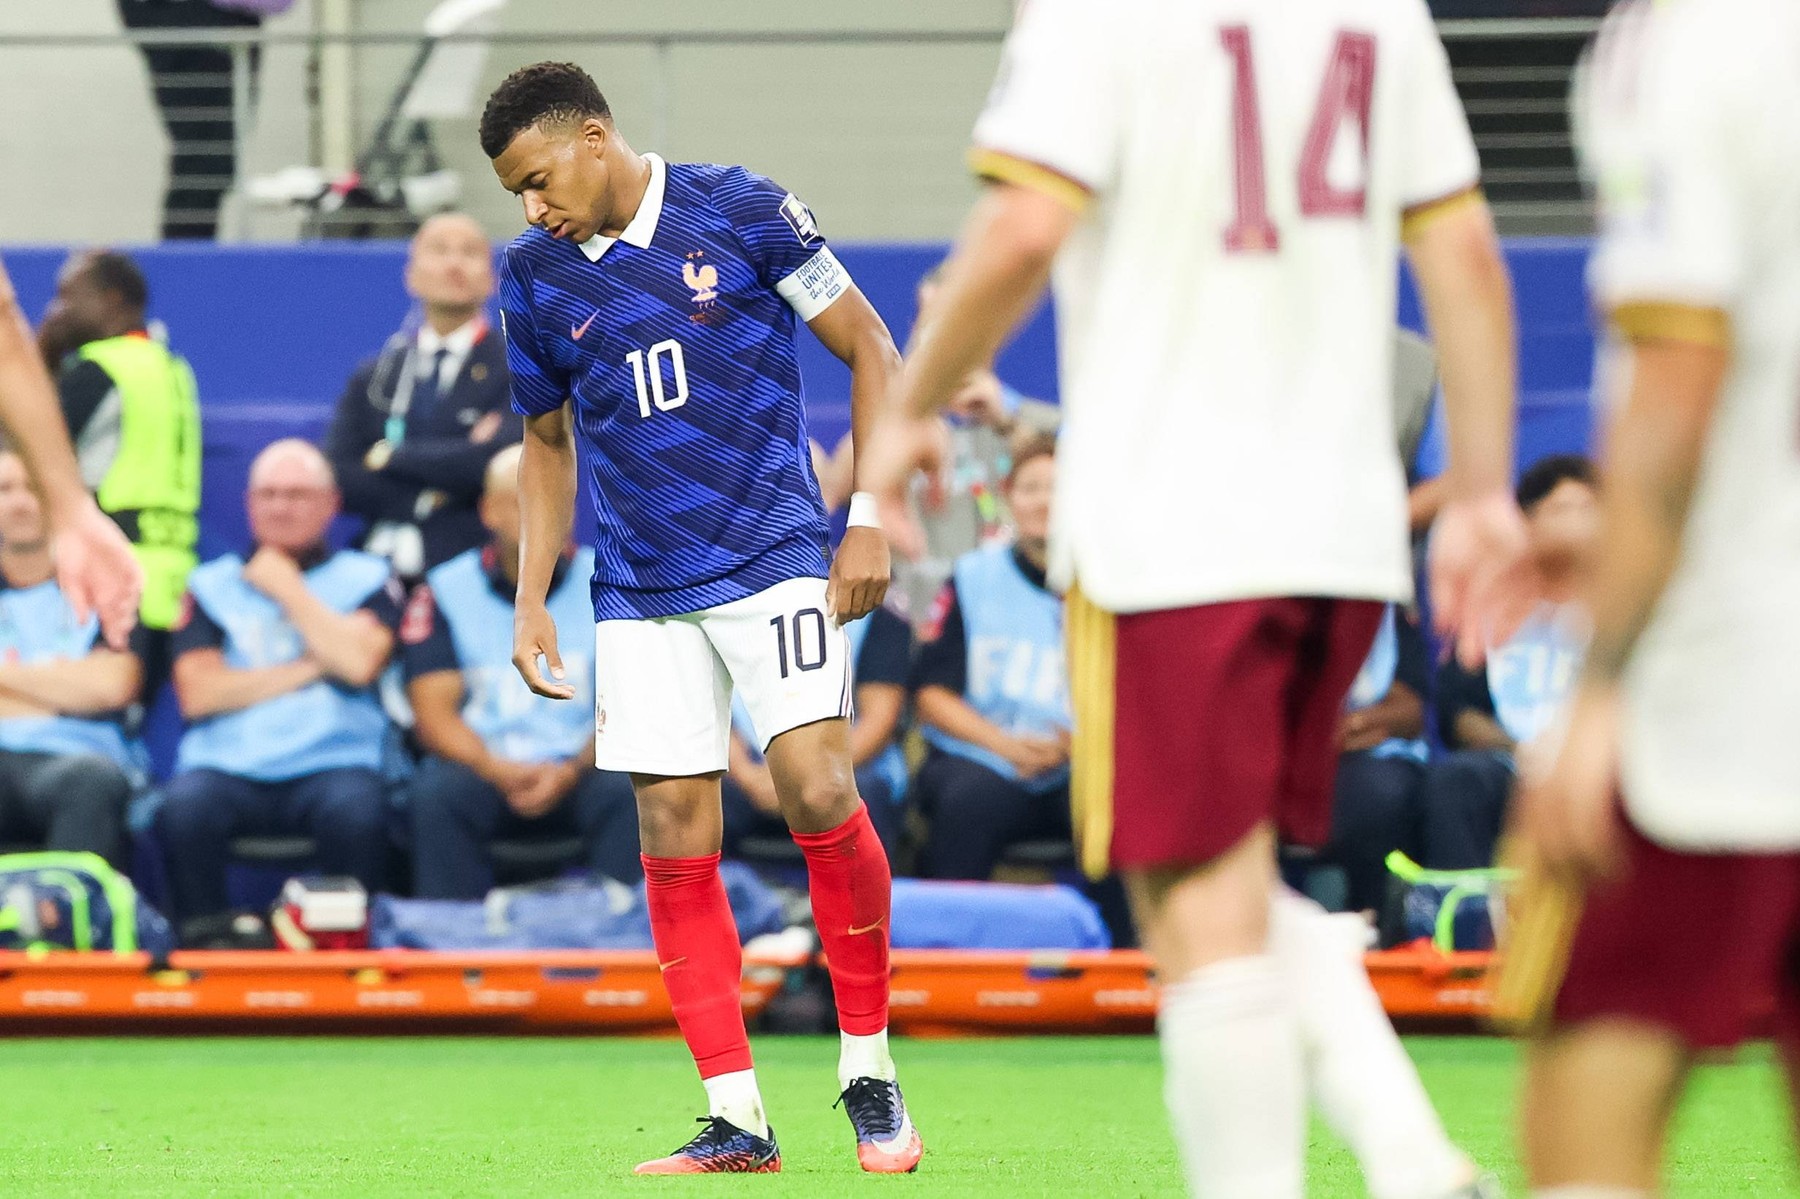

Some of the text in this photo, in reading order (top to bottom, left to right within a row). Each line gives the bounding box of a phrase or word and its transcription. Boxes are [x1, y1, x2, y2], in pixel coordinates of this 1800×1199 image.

[1218, 24, 1376, 252] 14
[796, 251, 825, 280] FOOTBALL
[801, 257, 833, 290] UNITES
[808, 288, 824, 300] the
[820, 267, 840, 289] World
[625, 338, 690, 419] 10
[770, 607, 827, 679] 10
